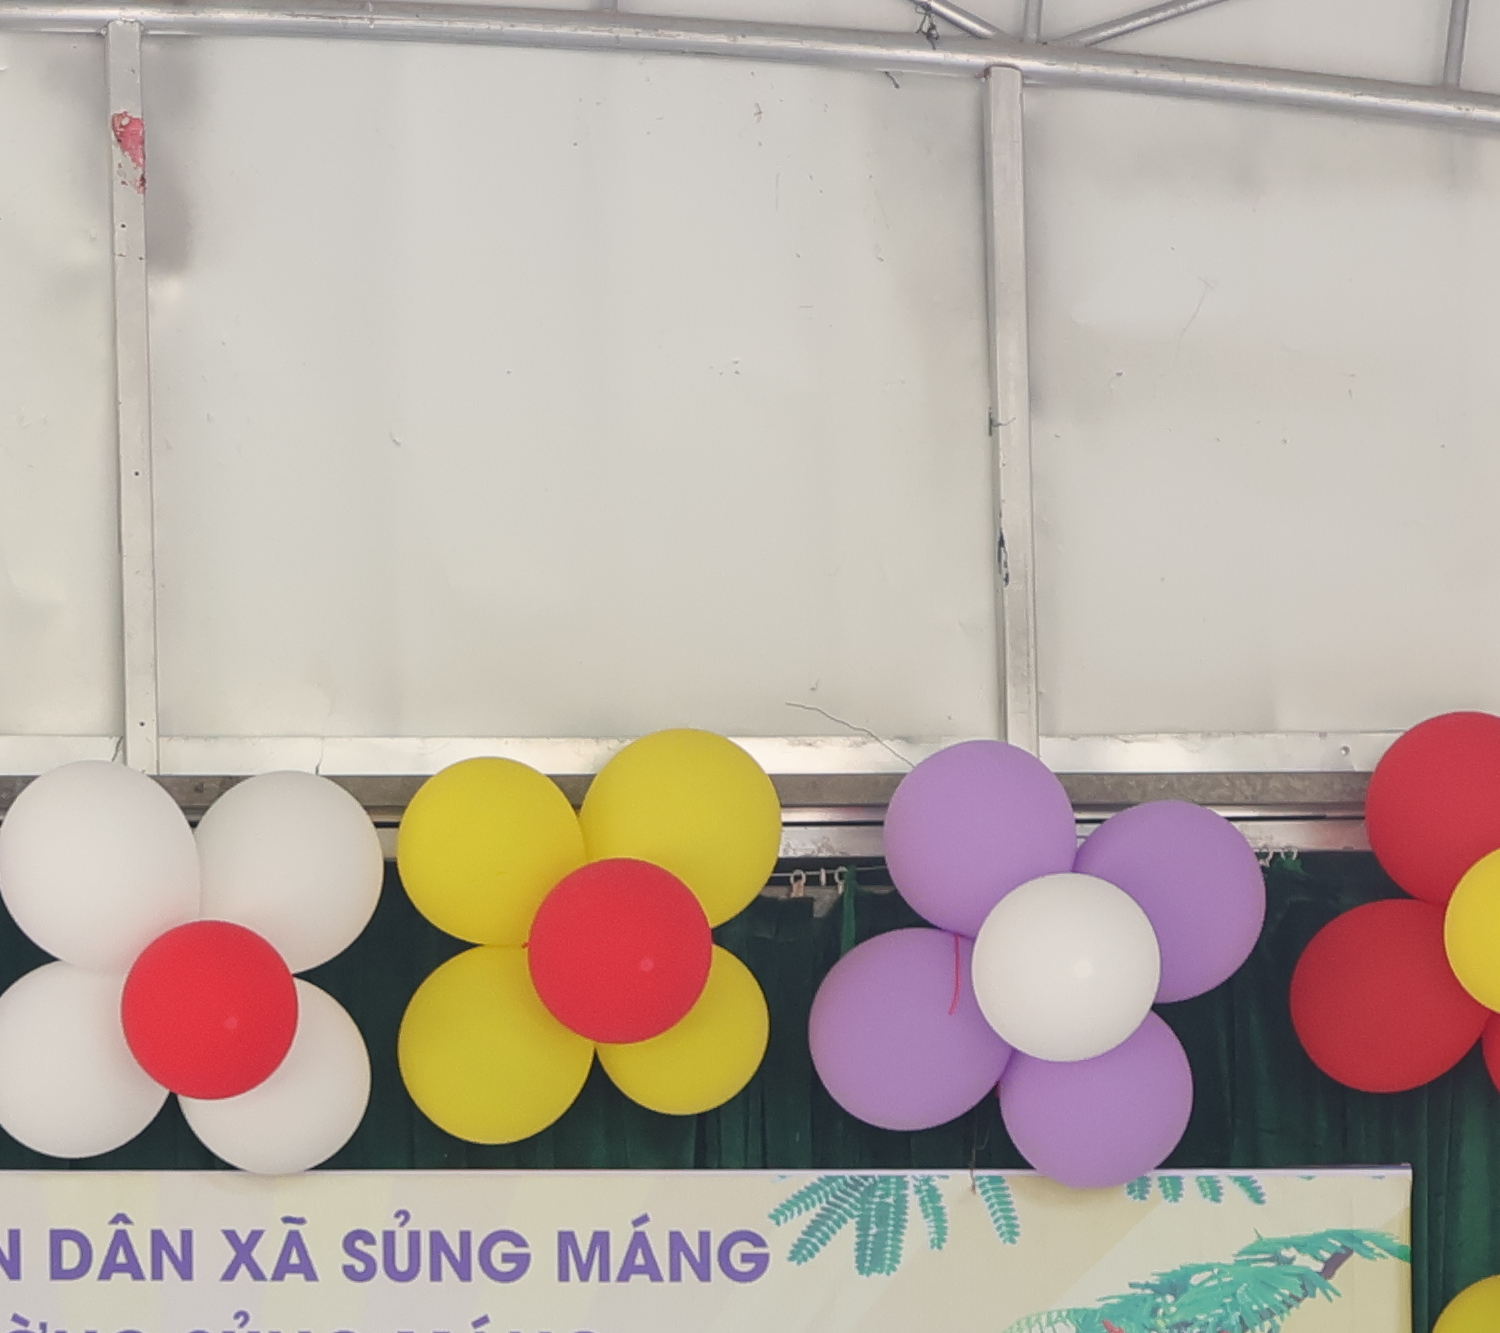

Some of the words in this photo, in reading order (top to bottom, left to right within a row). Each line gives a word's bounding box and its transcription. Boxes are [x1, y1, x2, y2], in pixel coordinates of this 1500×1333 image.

[48, 1213, 194, 1282] DÂN
[220, 1214, 320, 1283] XÃ
[341, 1209, 532, 1284] SỦNG
[556, 1213, 771, 1284] MÁNG
